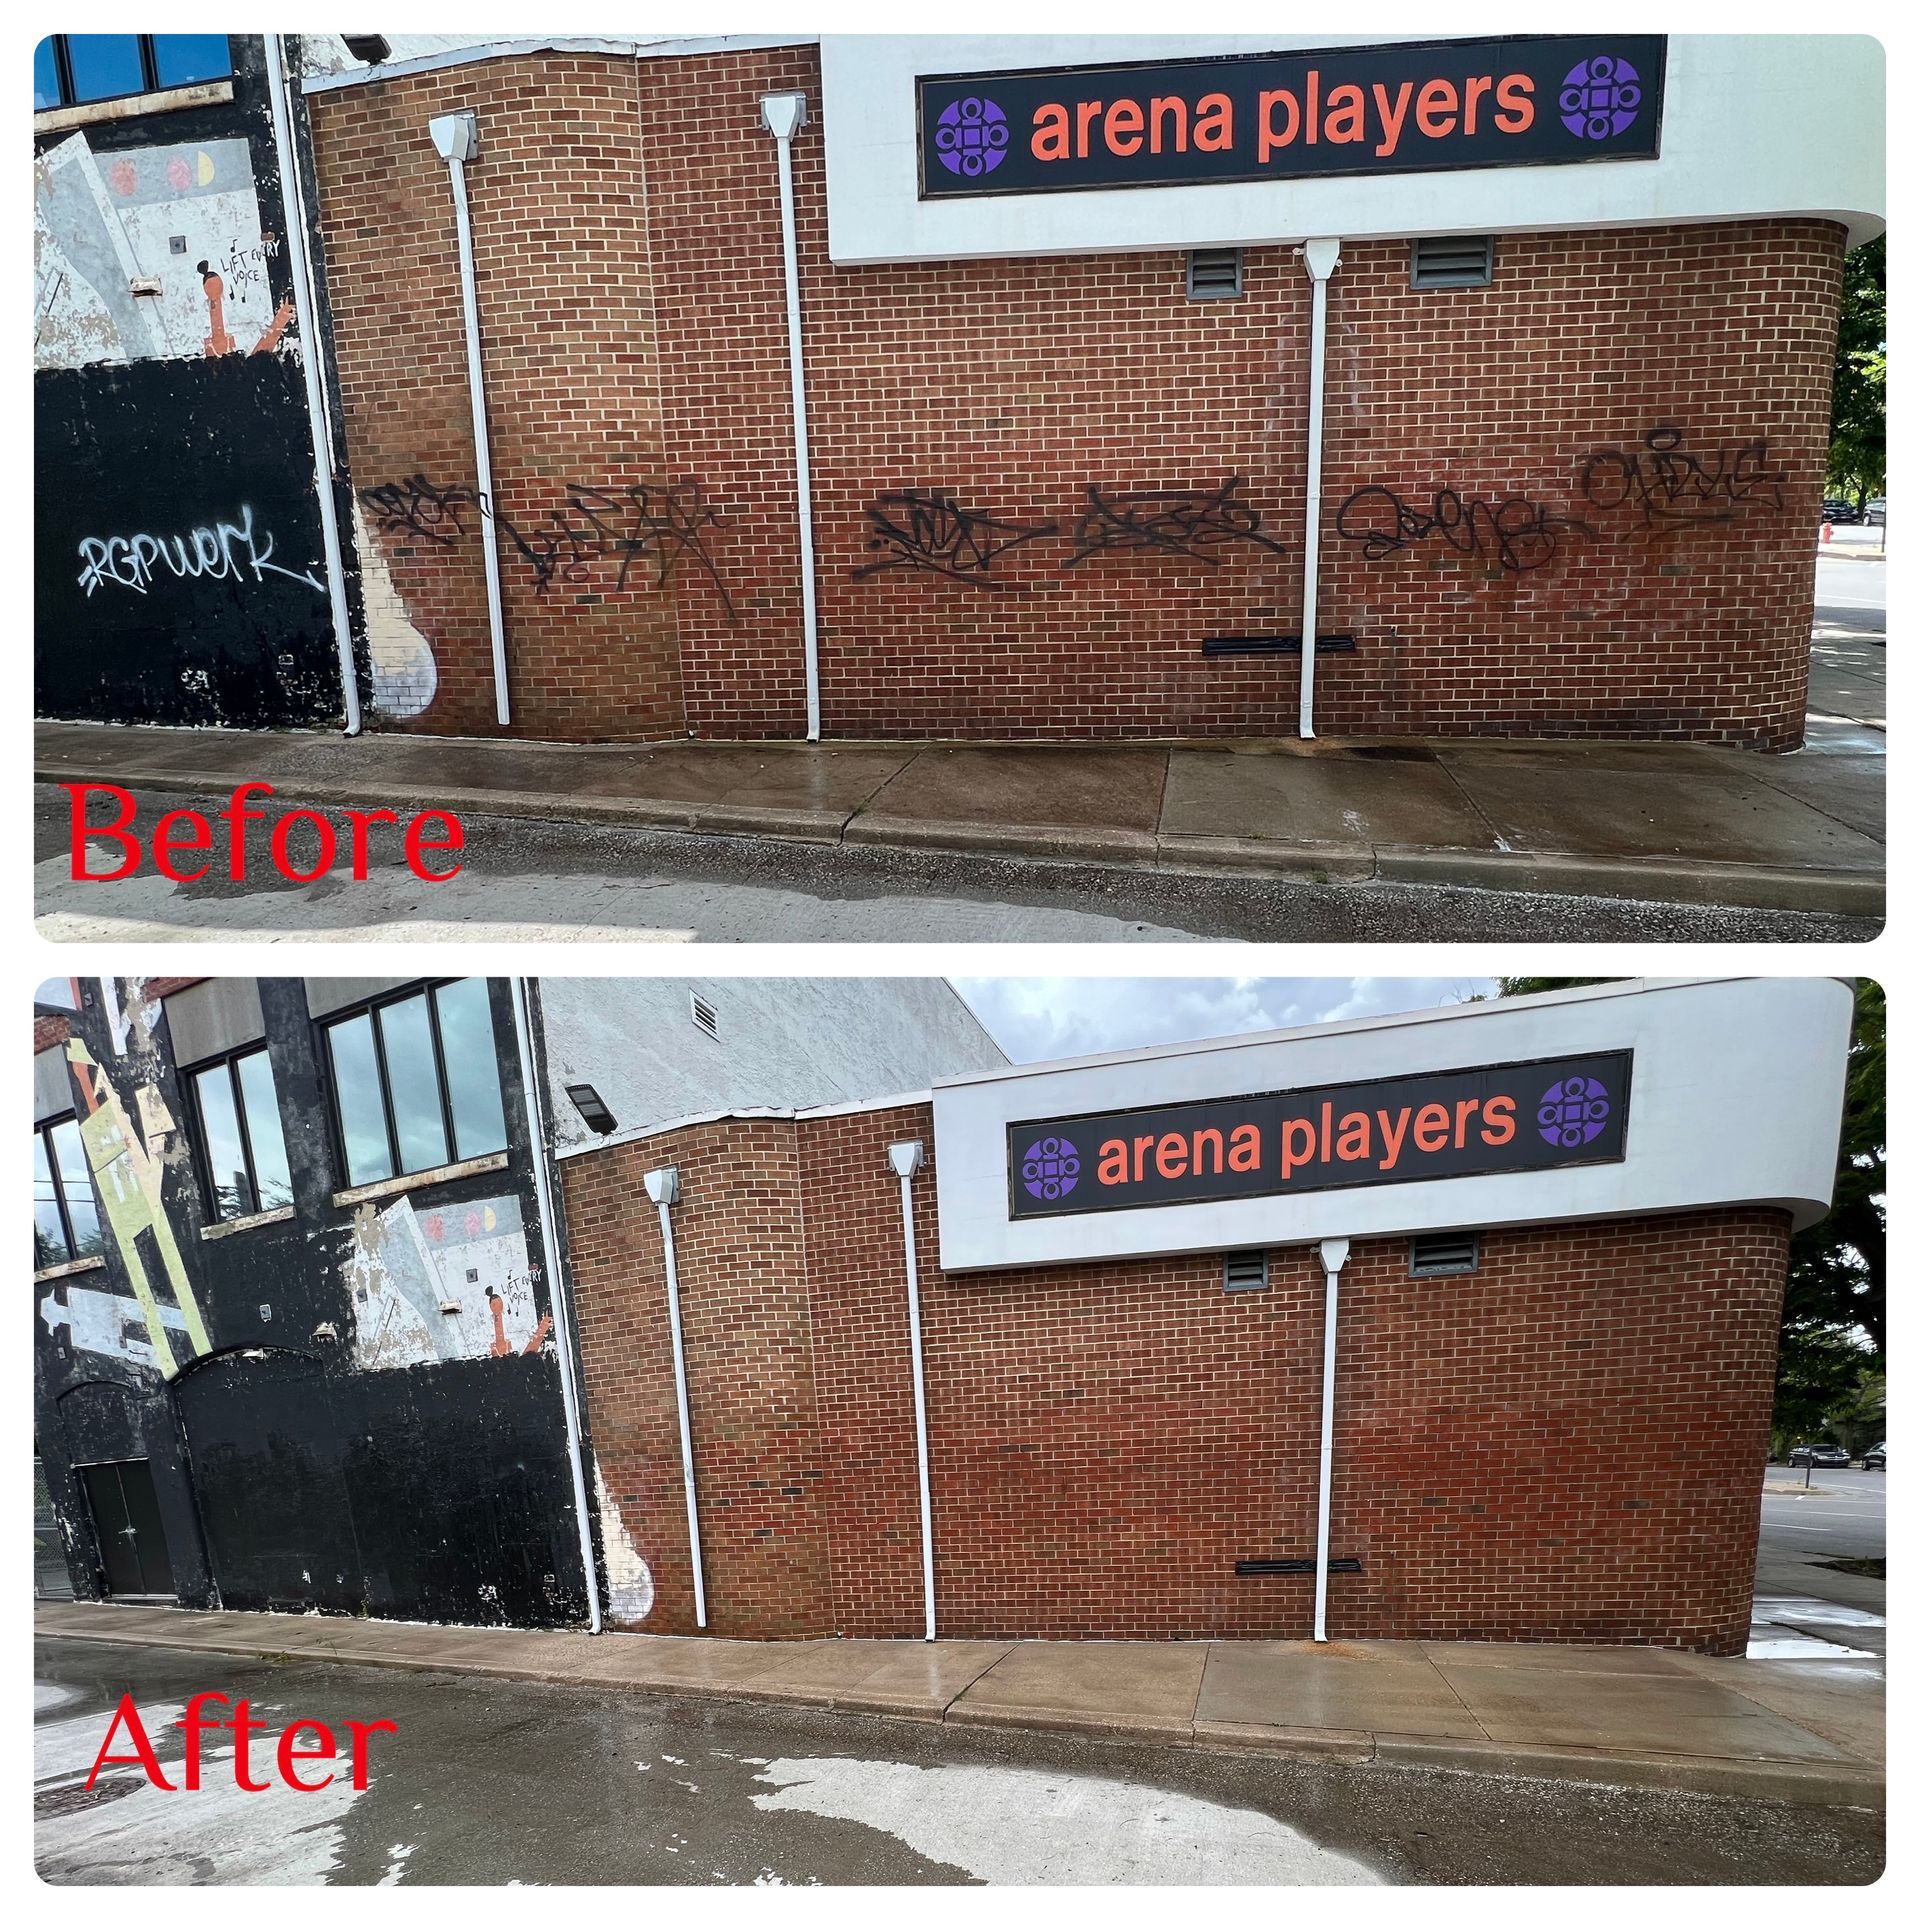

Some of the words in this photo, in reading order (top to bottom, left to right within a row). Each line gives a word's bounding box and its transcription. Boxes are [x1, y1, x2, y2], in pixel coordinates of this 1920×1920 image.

[1030, 91, 1234, 162] arena
[1257, 69, 1536, 164] players
[220, 250, 248, 274] LIFT
[232, 269, 260, 288] VOICE
[1096, 1120, 1261, 1186] arena
[1280, 1095, 1518, 1179] players
[500, 1277, 520, 1296] LIFT
[509, 1291, 529, 1306] VOICE
